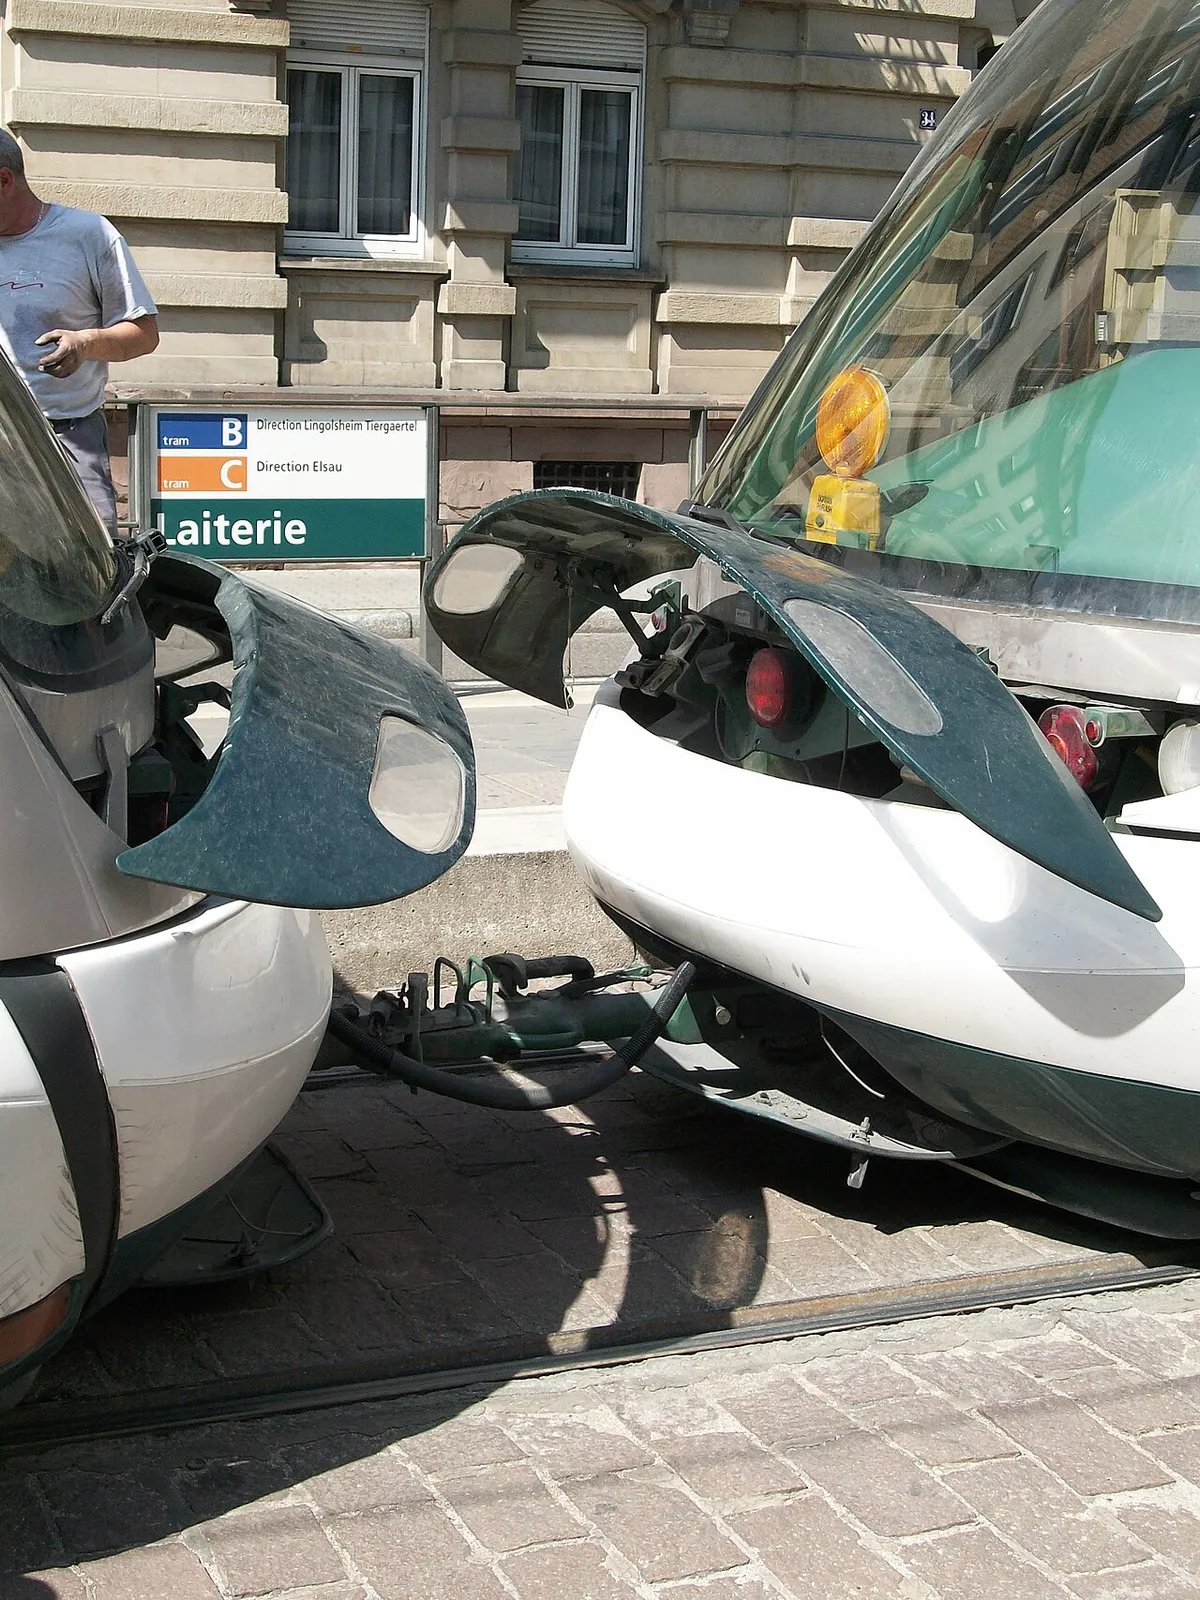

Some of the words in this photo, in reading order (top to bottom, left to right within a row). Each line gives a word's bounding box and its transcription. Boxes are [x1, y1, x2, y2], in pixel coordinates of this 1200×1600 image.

[921, 111, 935, 127] 34
[162, 435, 189, 446] tram
[221, 417, 243, 447] B
[256, 418, 302, 432] Direction
[304, 419, 363, 434] Lingolsheim
[365, 420, 417, 434] Tiergaertel
[163, 478, 189, 488] tram
[220, 459, 243, 489] C
[256, 460, 310, 473] Direction
[313, 461, 342, 473] Elsau
[157, 511, 307, 546] Laiterie
